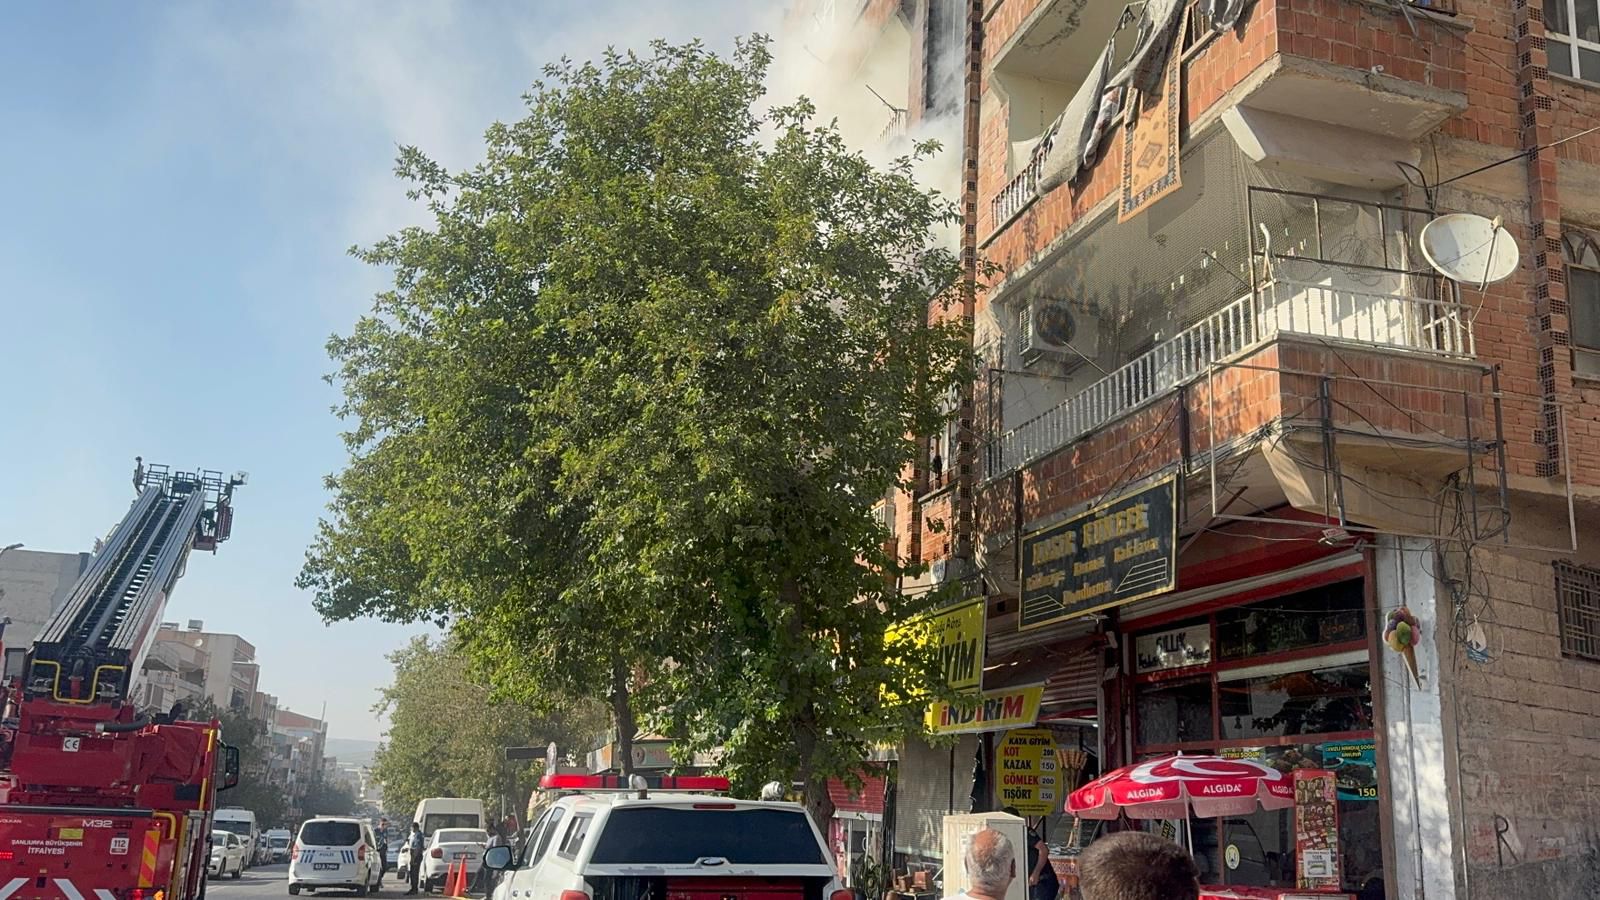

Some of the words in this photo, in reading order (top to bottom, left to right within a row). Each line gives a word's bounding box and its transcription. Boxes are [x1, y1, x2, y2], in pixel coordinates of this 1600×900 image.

[1004, 746, 1020, 757] KOT
[1004, 760, 1032, 770] KAZAK
[1042, 762, 1055, 770] 150
[1004, 772, 1039, 785] GÖMLEK
[1358, 787, 1377, 797] 150
[82, 819, 113, 828] M32
[113, 839, 126, 848] 112
[1494, 811, 1519, 868] R
[27, 846, 65, 855] İTFAİYESİ
